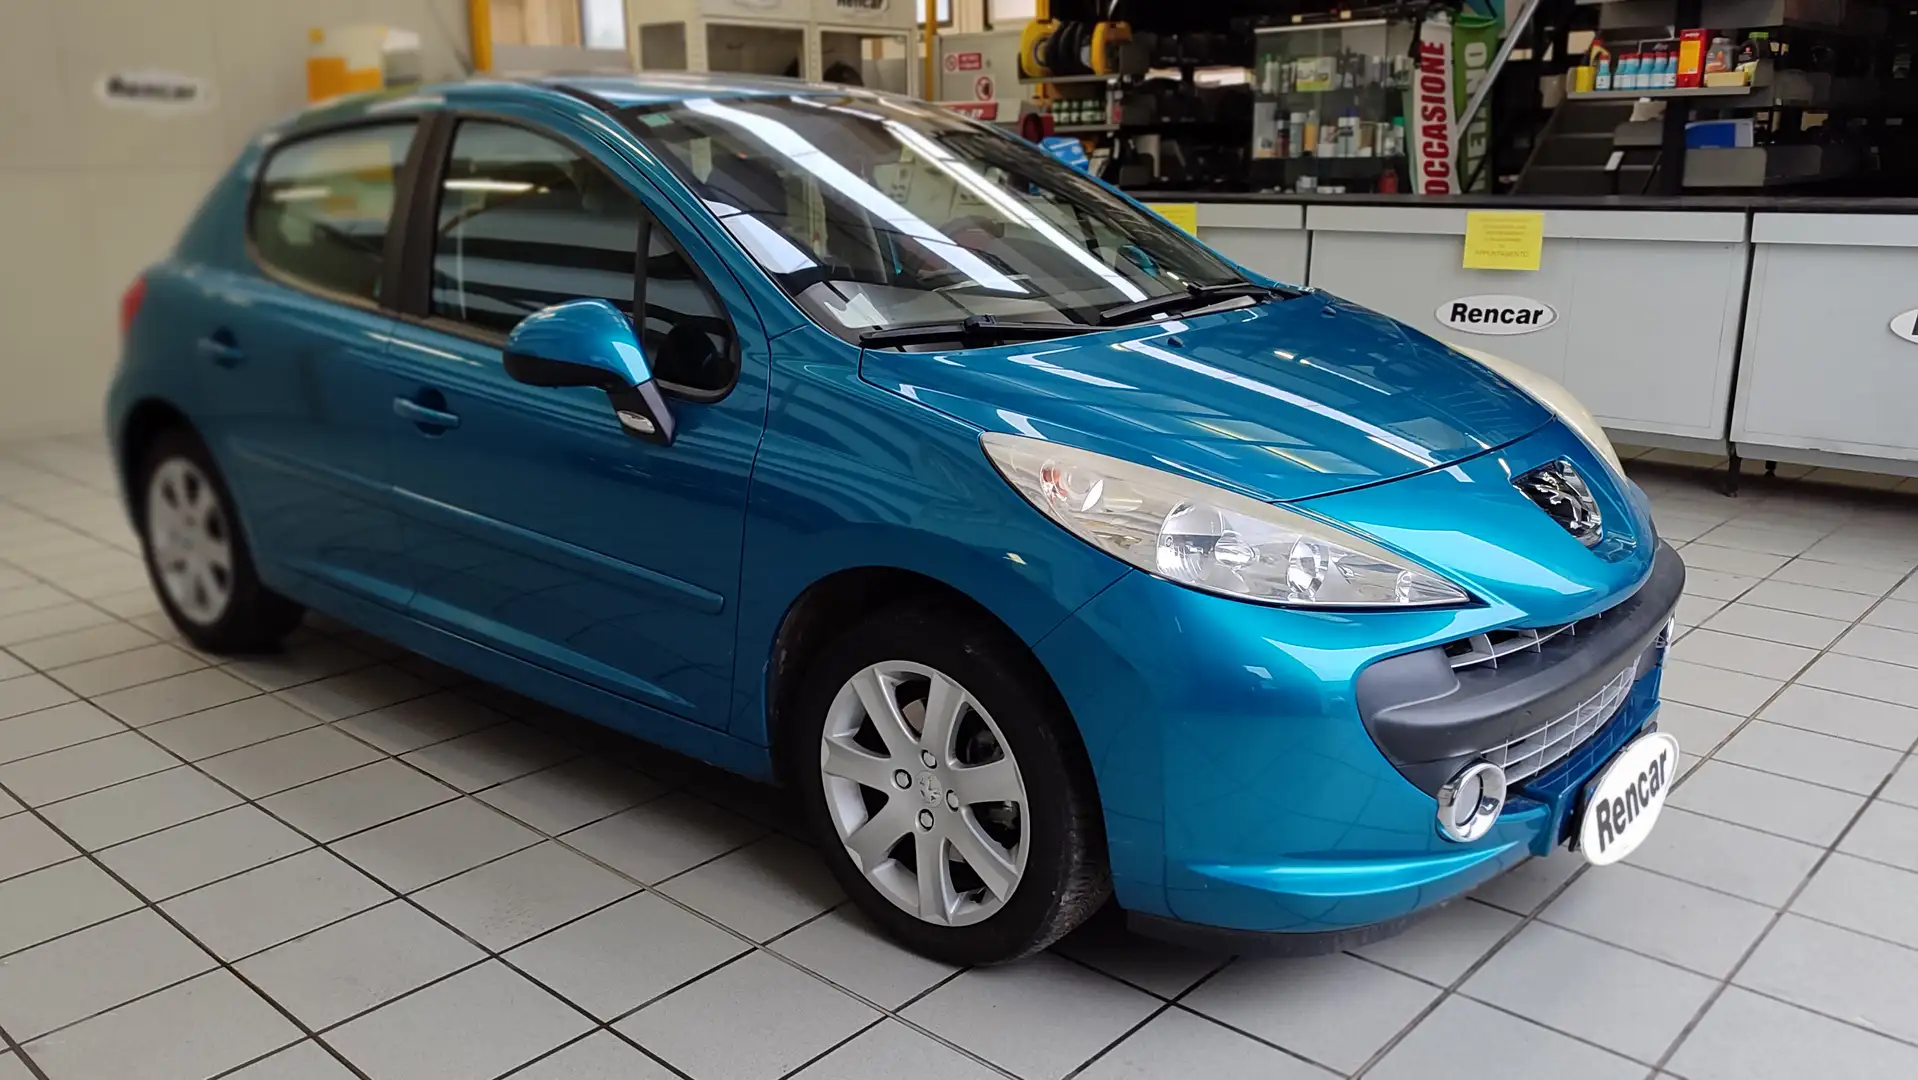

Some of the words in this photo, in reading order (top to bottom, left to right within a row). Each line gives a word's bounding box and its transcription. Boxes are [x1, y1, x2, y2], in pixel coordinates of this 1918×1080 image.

[1419, 41, 1450, 194] OCCASIONE
[1450, 302, 1543, 325] Rencar
[1596, 748, 1667, 854] Rencar
